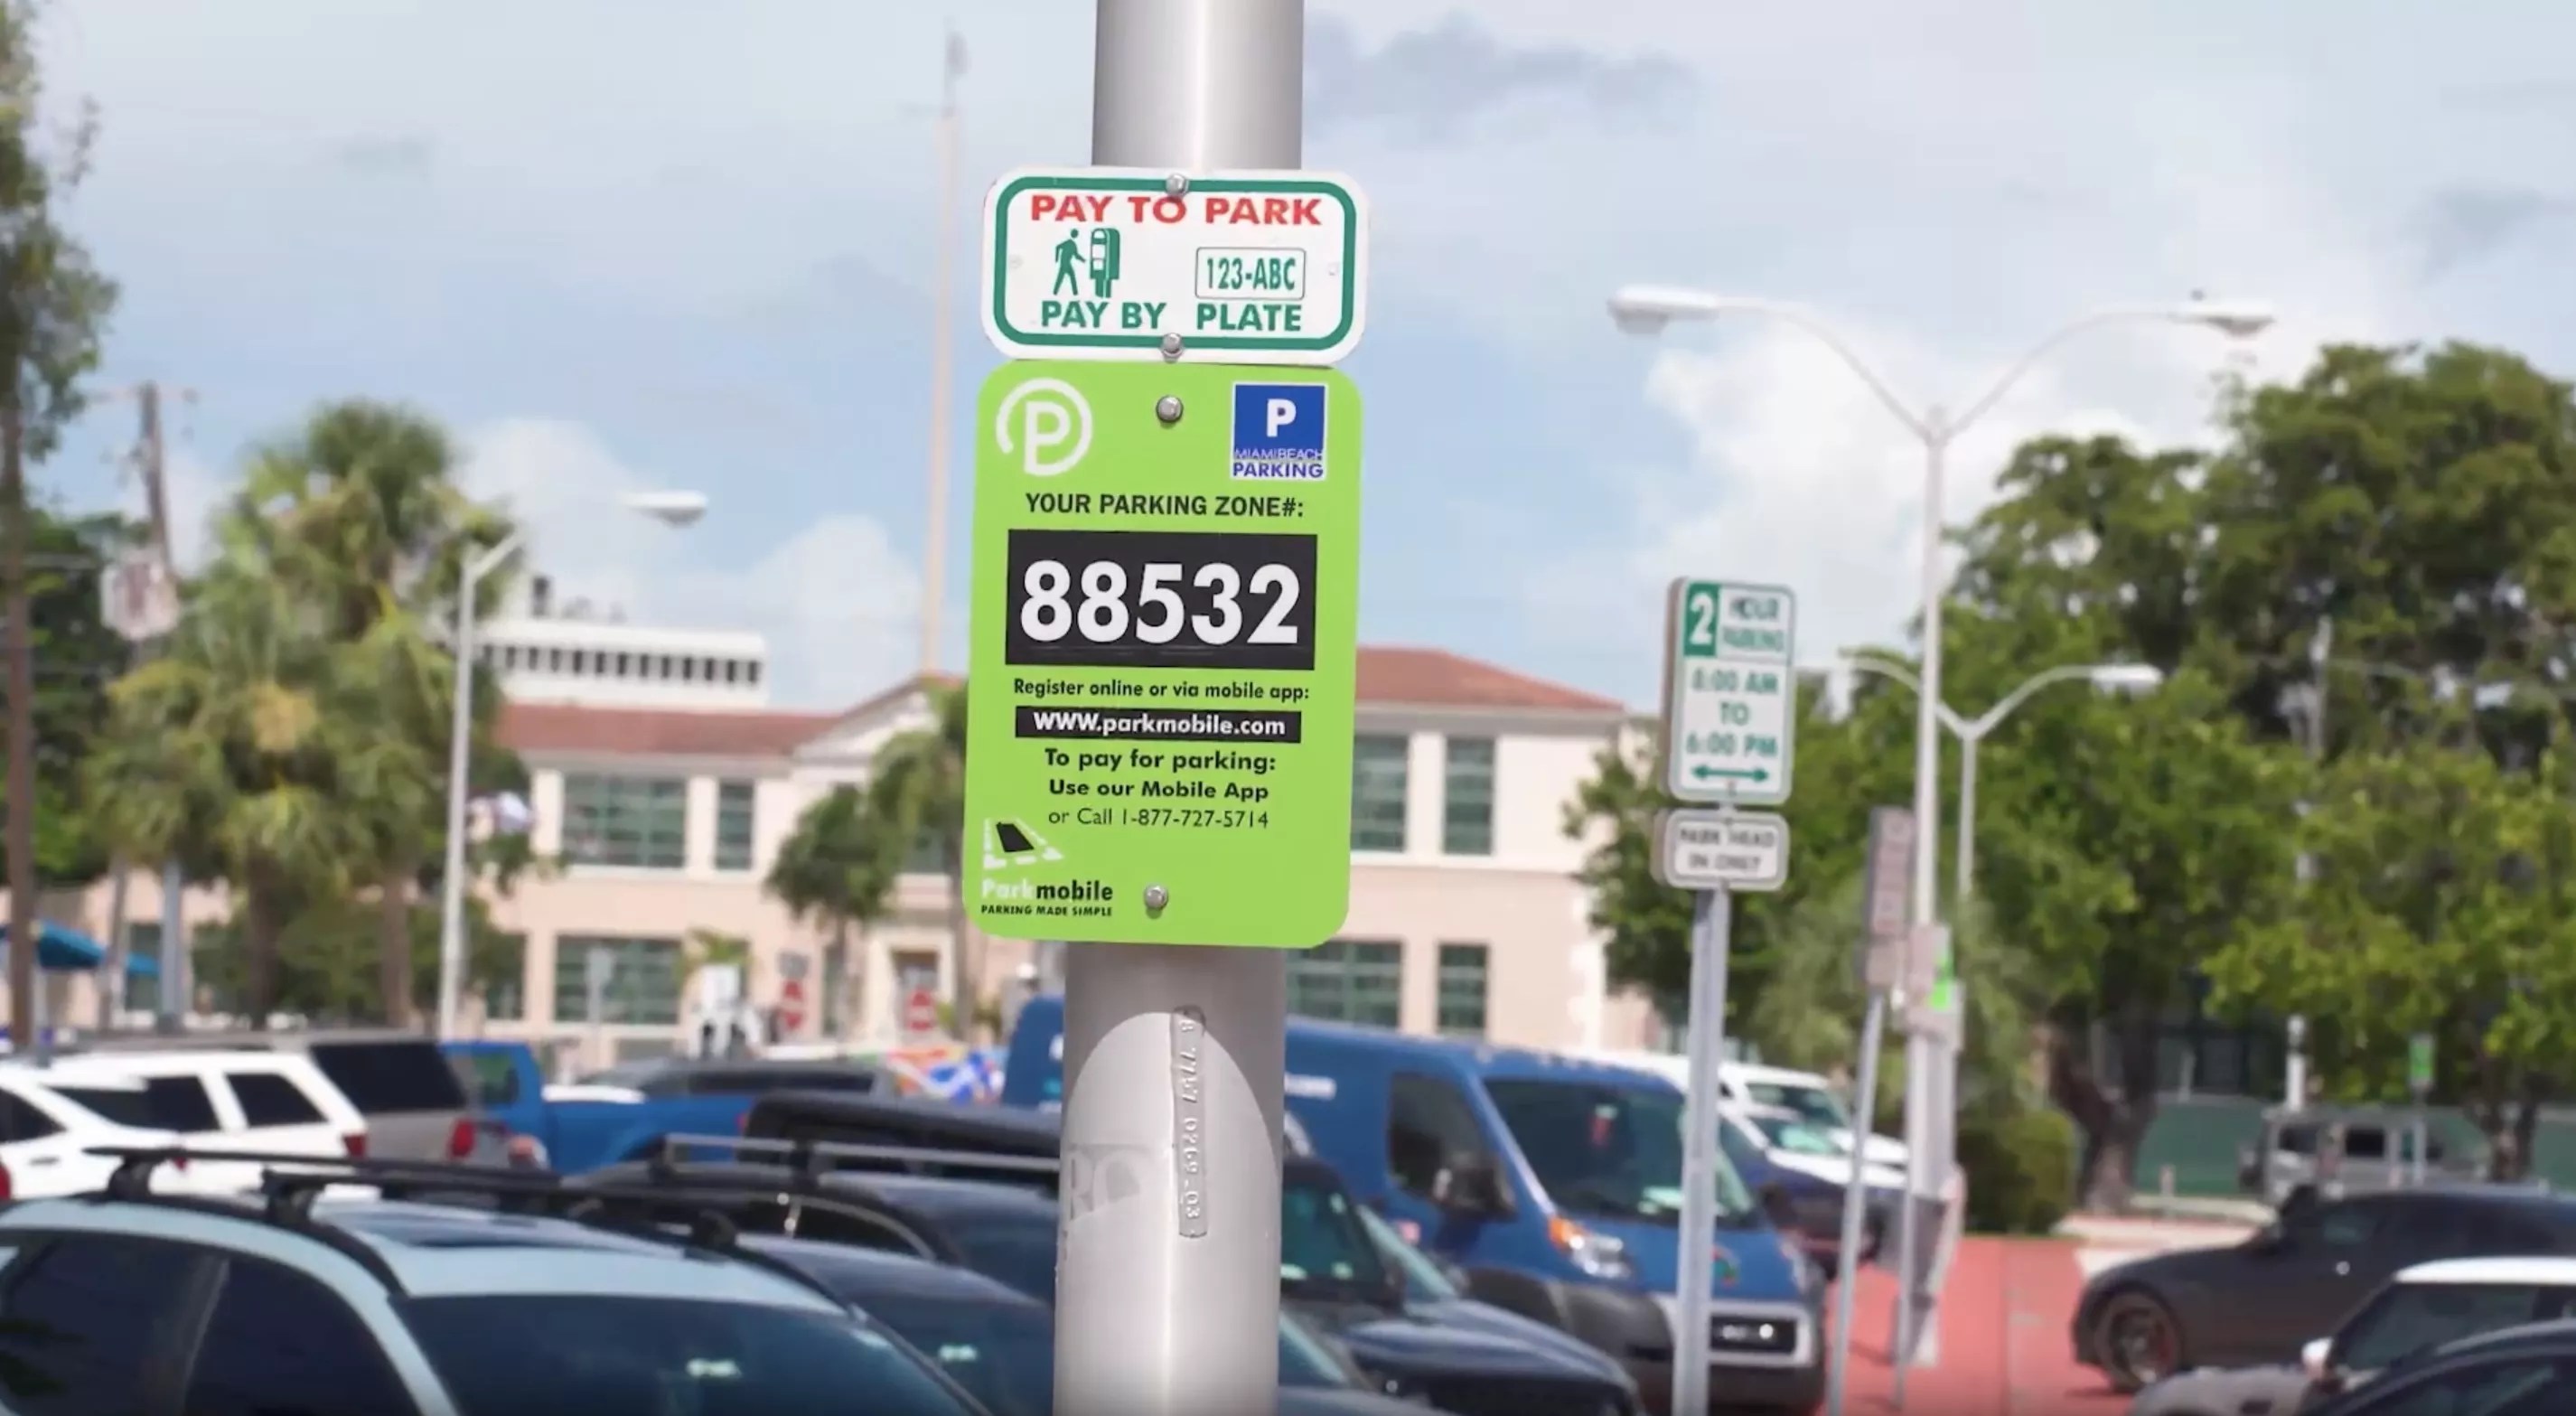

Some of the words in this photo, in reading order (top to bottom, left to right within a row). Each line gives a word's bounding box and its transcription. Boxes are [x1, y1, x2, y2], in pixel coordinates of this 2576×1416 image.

[1031, 194, 1115, 222] PAY
[1127, 196, 1189, 223] TO
[1205, 197, 1325, 225] PARK
[1206, 257, 1296, 291] 123-ABC
[1041, 298, 1110, 329] PAY
[1121, 302, 1167, 330] BY
[1196, 302, 1303, 332] PLATE
[1266, 398, 1297, 437] P
[1232, 462, 1324, 479] PARKING
[1026, 492, 1091, 514] YOUR
[1100, 493, 1207, 516] PARKING
[1213, 495, 1304, 518] ZONE#:
[1020, 559, 1300, 645] 88532
[1689, 592, 1714, 645] 2
[1014, 678, 1085, 698] Register
[1089, 679, 1144, 697] online
[1148, 684, 1168, 697] or
[1172, 680, 1199, 698] via
[1204, 681, 1264, 699] mobile
[1269, 687, 1309, 703] app:
[1718, 701, 1751, 726] TO
[1044, 747, 1070, 766] To
[1078, 753, 1123, 772] pay
[1129, 748, 1165, 768] for
[1172, 750, 1276, 775] parking:
[1049, 778, 1090, 796] Use
[1097, 783, 1135, 797] our
[1141, 780, 1217, 799] Mobile
[1223, 783, 1269, 802] App
[1048, 811, 1071, 825] or
[1076, 807, 1112, 825] Call
[1122, 808, 1269, 829] 1-877-727-5714
[981, 878, 1113, 904] Parkmobile
[980, 904, 1033, 915] PARKING
[1035, 905, 1068, 916] MADE
[1072, 905, 1112, 917] SIMPLE
